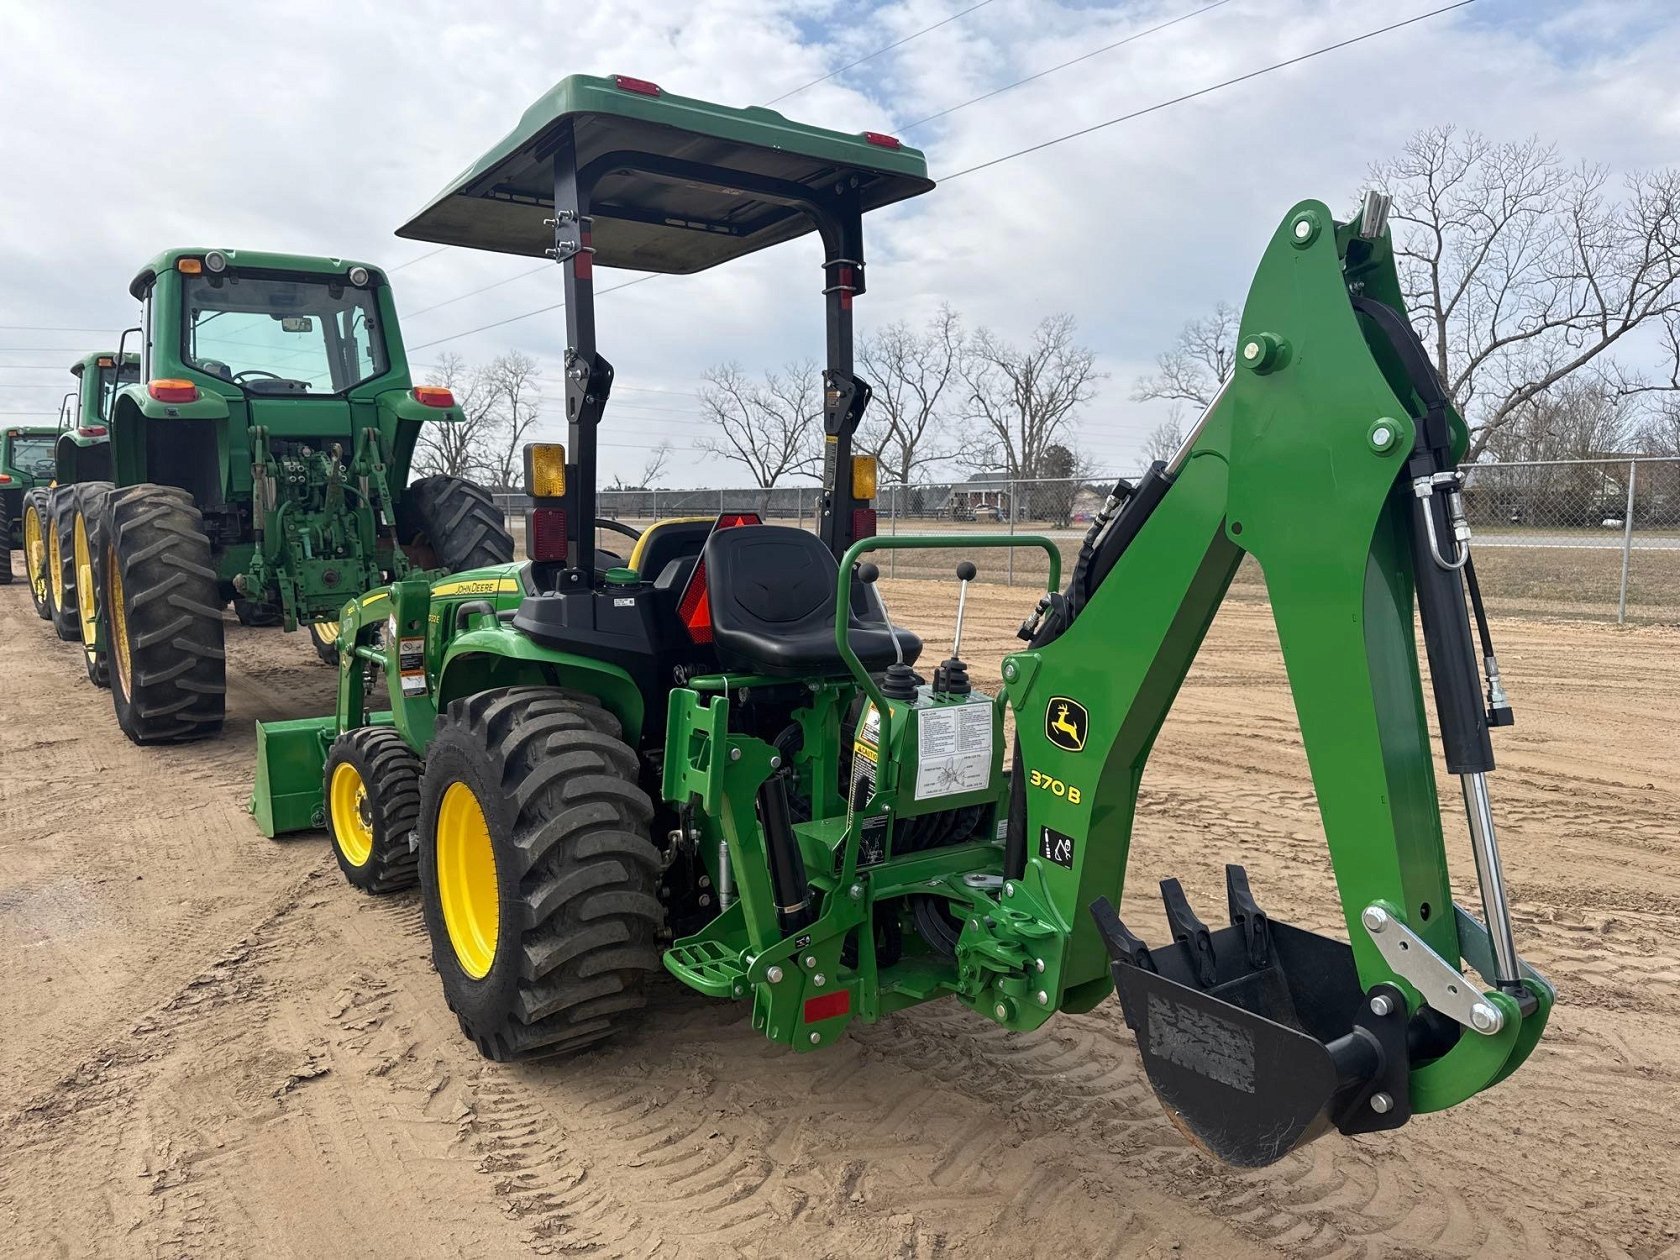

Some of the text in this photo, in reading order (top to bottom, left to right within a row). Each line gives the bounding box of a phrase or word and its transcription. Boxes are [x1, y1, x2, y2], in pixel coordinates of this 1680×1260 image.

[455, 583, 494, 593] JOHN DEERE
[862, 747, 878, 761] CAUTIO
[1029, 770, 1082, 804] 370 B
